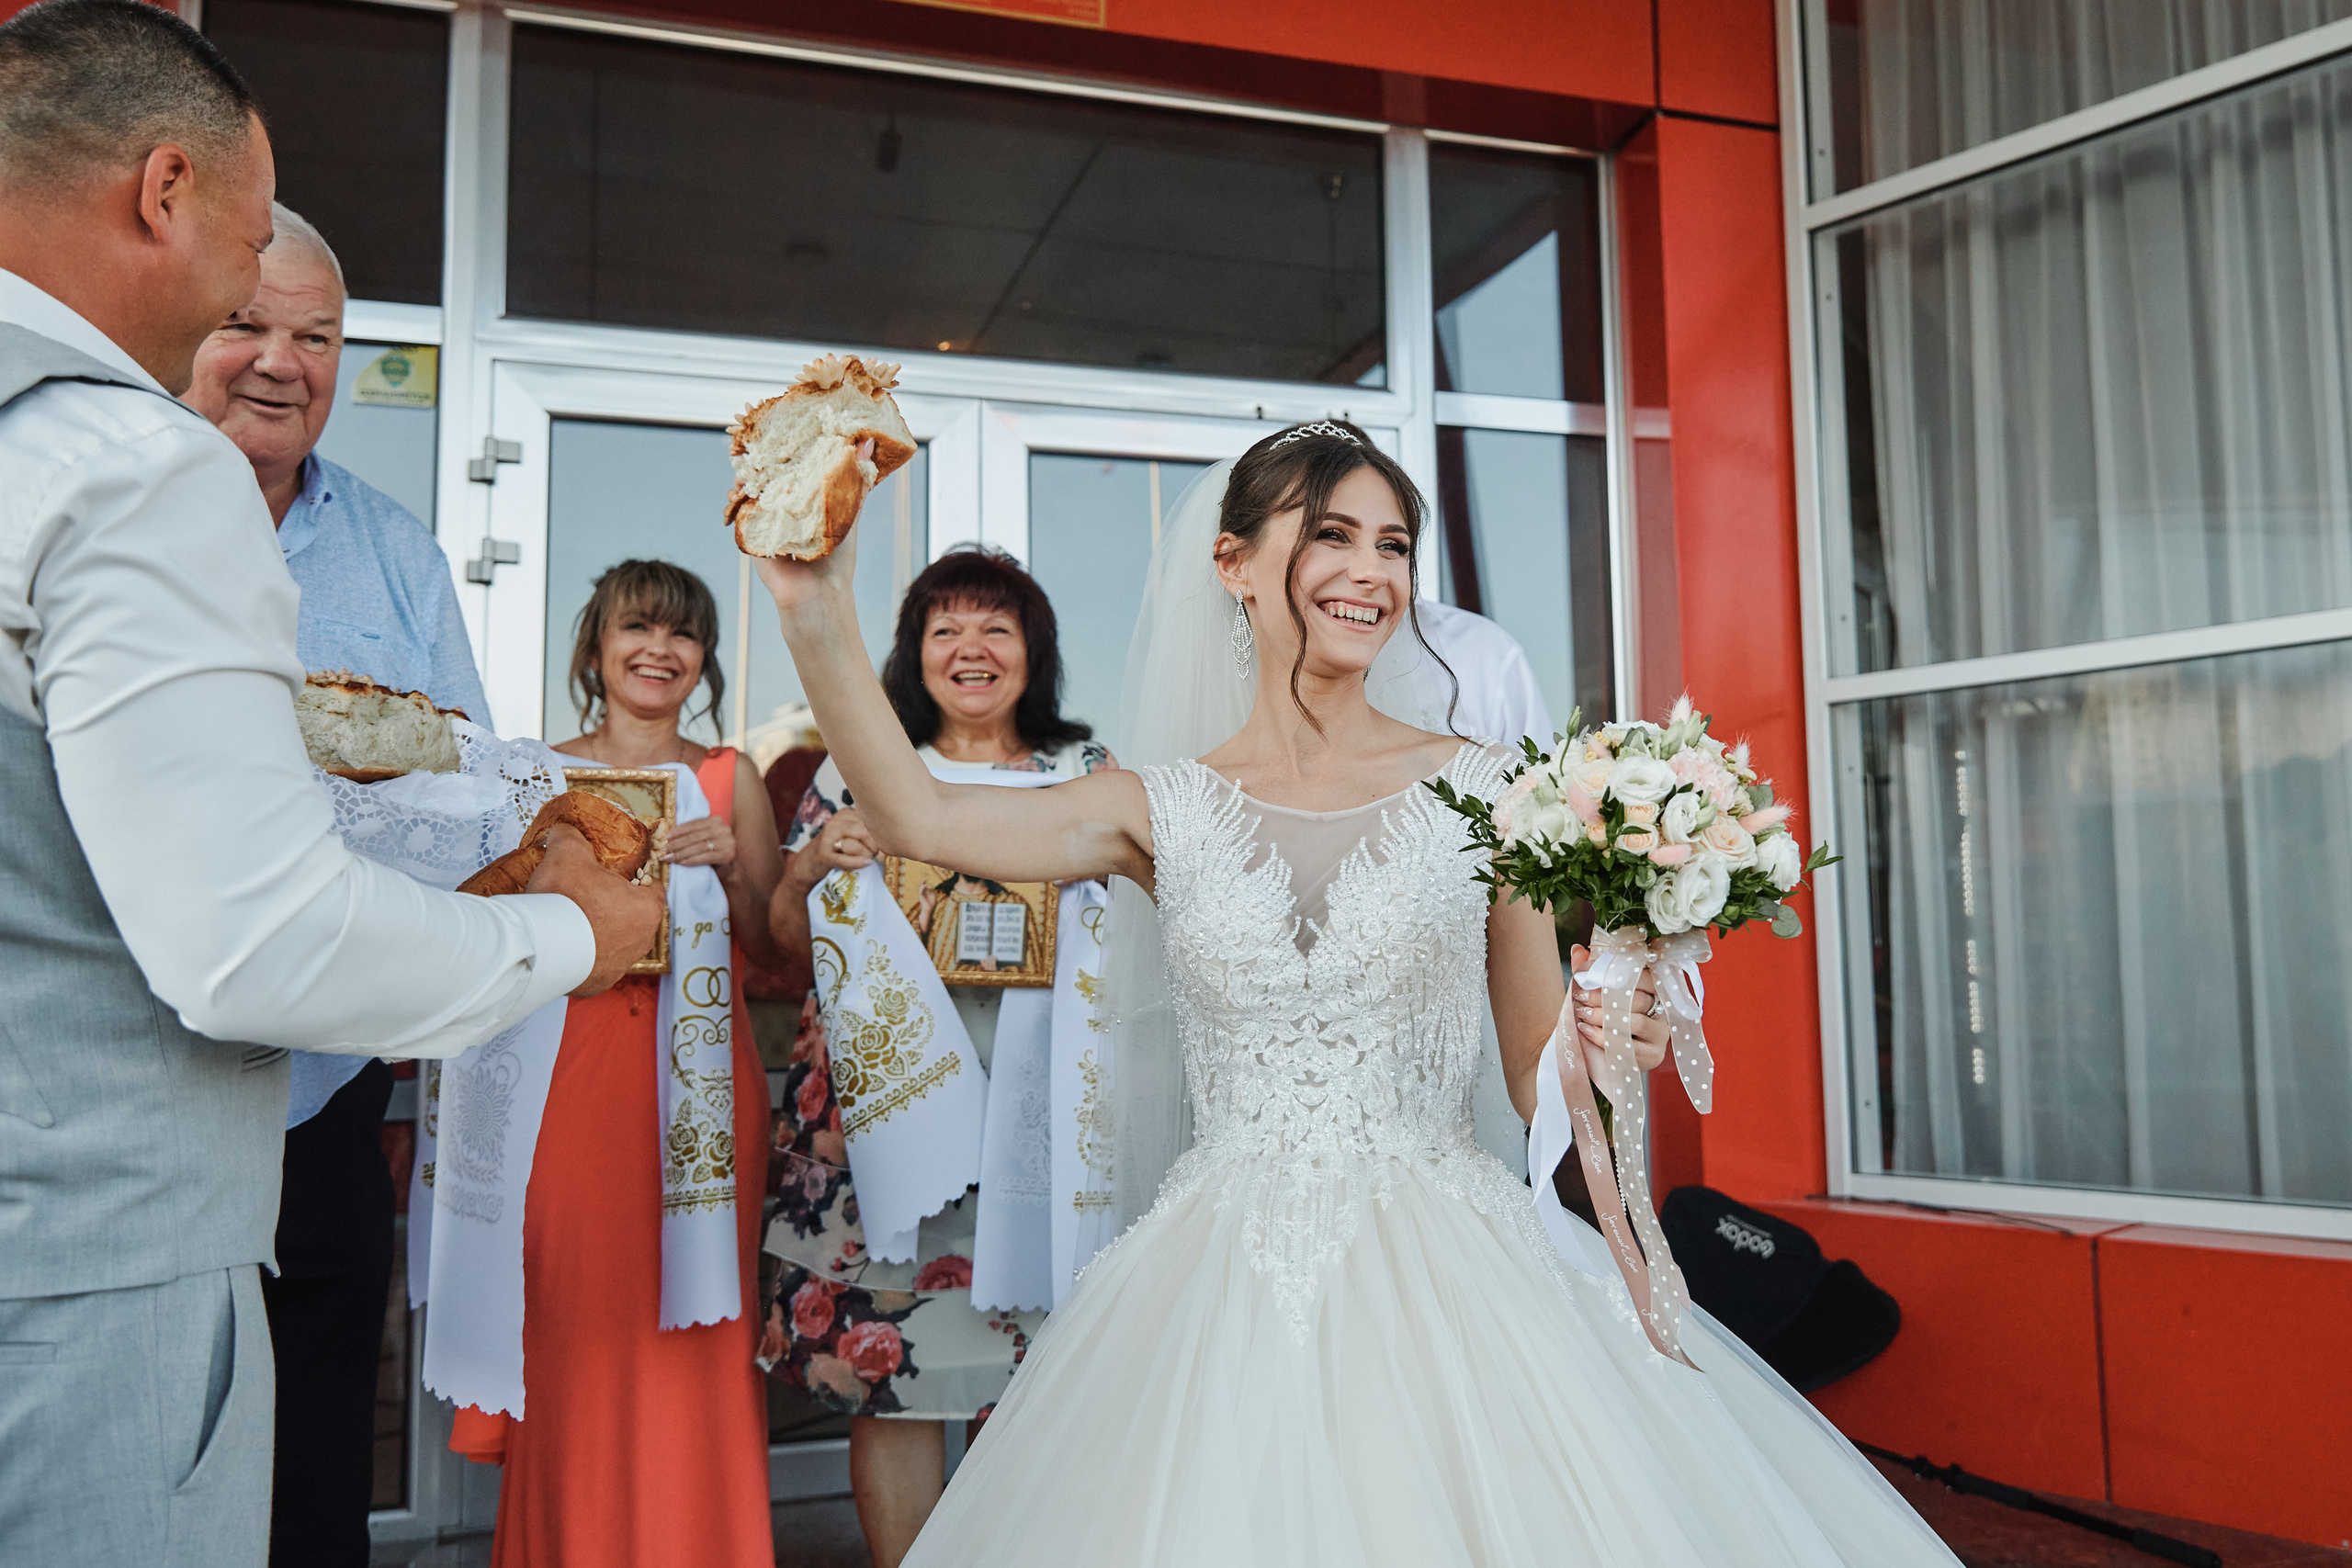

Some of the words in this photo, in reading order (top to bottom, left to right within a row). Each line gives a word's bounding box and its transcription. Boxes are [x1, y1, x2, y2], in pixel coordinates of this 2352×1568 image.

[1564, 1041, 1575, 1069] love
[1573, 1107, 1600, 1145] forever
[1590, 1145, 1602, 1175] love
[1600, 1213, 1630, 1250] forever
[1622, 1249, 1639, 1273] love
[1715, 1217, 1776, 1258] Godox
